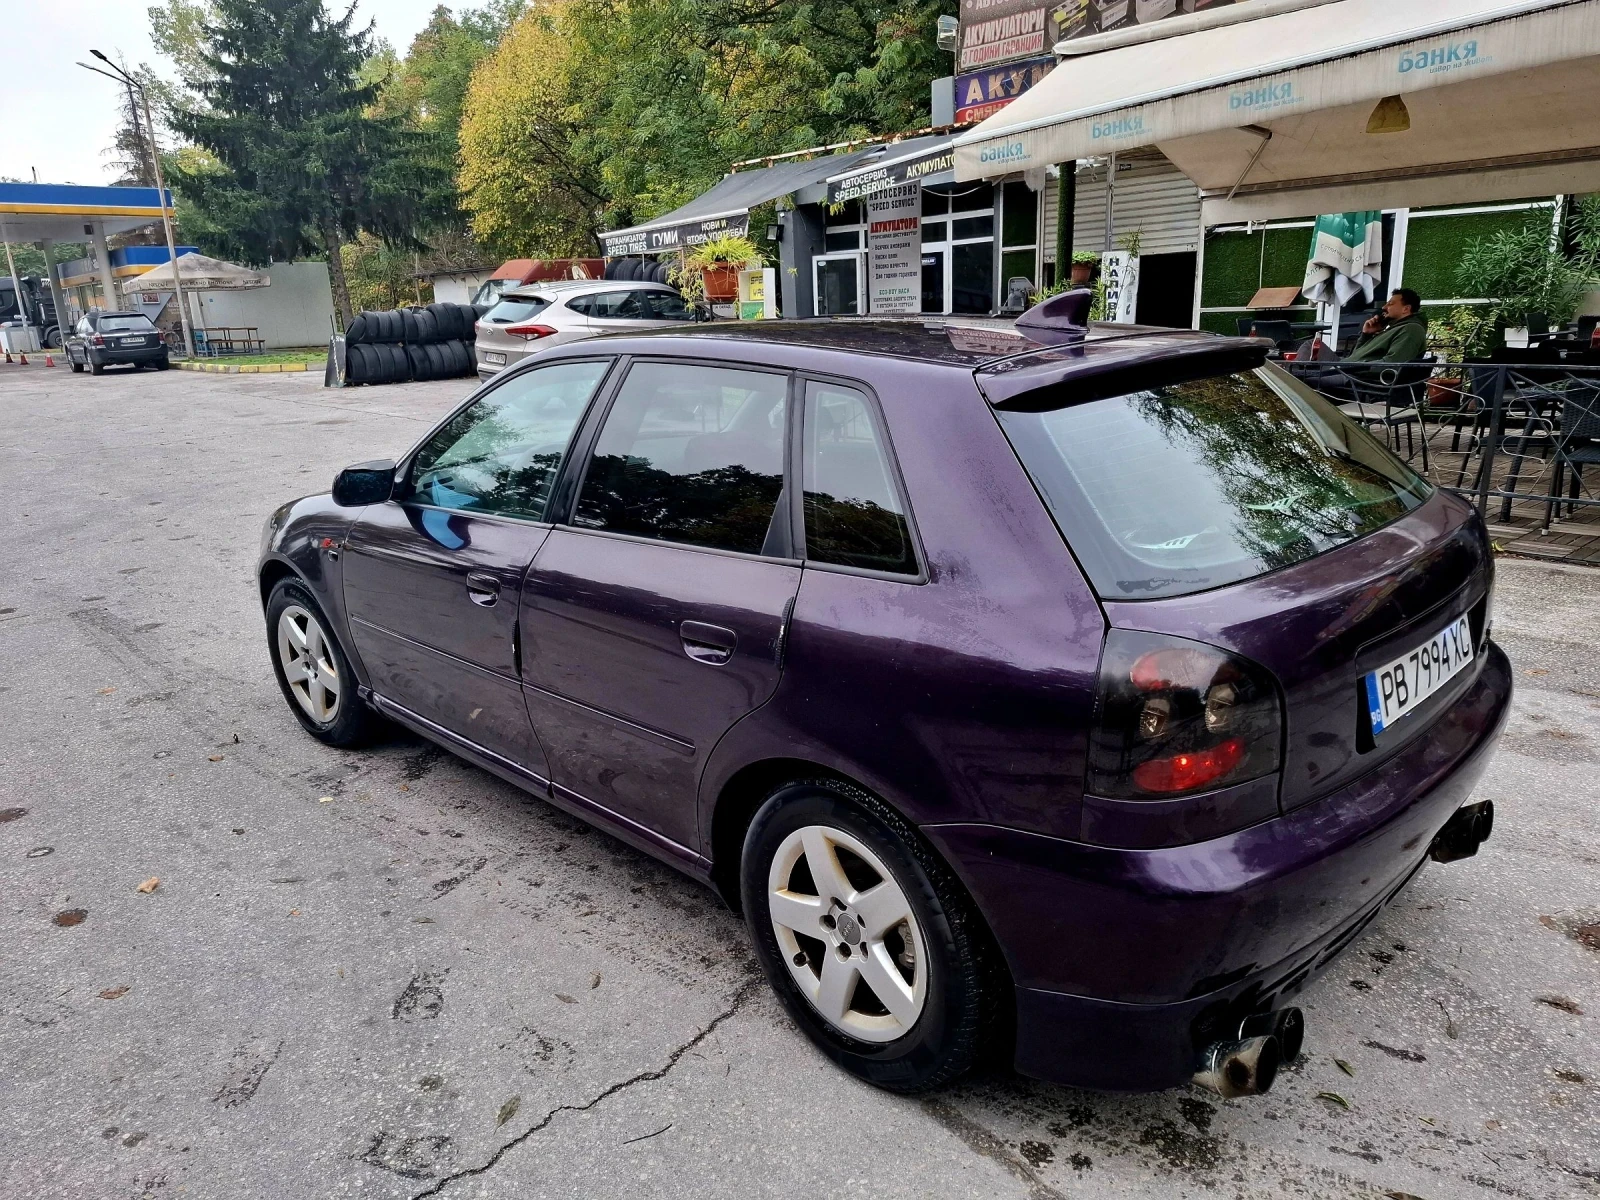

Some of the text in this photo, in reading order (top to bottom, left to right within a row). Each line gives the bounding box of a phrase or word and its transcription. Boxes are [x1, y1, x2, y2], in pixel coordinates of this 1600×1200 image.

[963, 8, 1045, 48] АКУМУЛАТОРИ
[969, 44, 1000, 63] ГОДИНИ
[1002, 34, 1043, 57] ГАРАНЦИЯ
[841, 168, 887, 189] АВТОСЕРВИЗ
[834, 176, 896, 202] SPEED SERVICE
[869, 184, 918, 200] АВТОСЕРВИЗ
[701, 221, 720, 231] НОВИ
[652, 230, 678, 247] ГУМИ
[686, 233, 707, 244] ВТОРА
[607, 241, 647, 256] SPEED TIRES
[1380, 618, 1470, 717] PB 7994 XC
